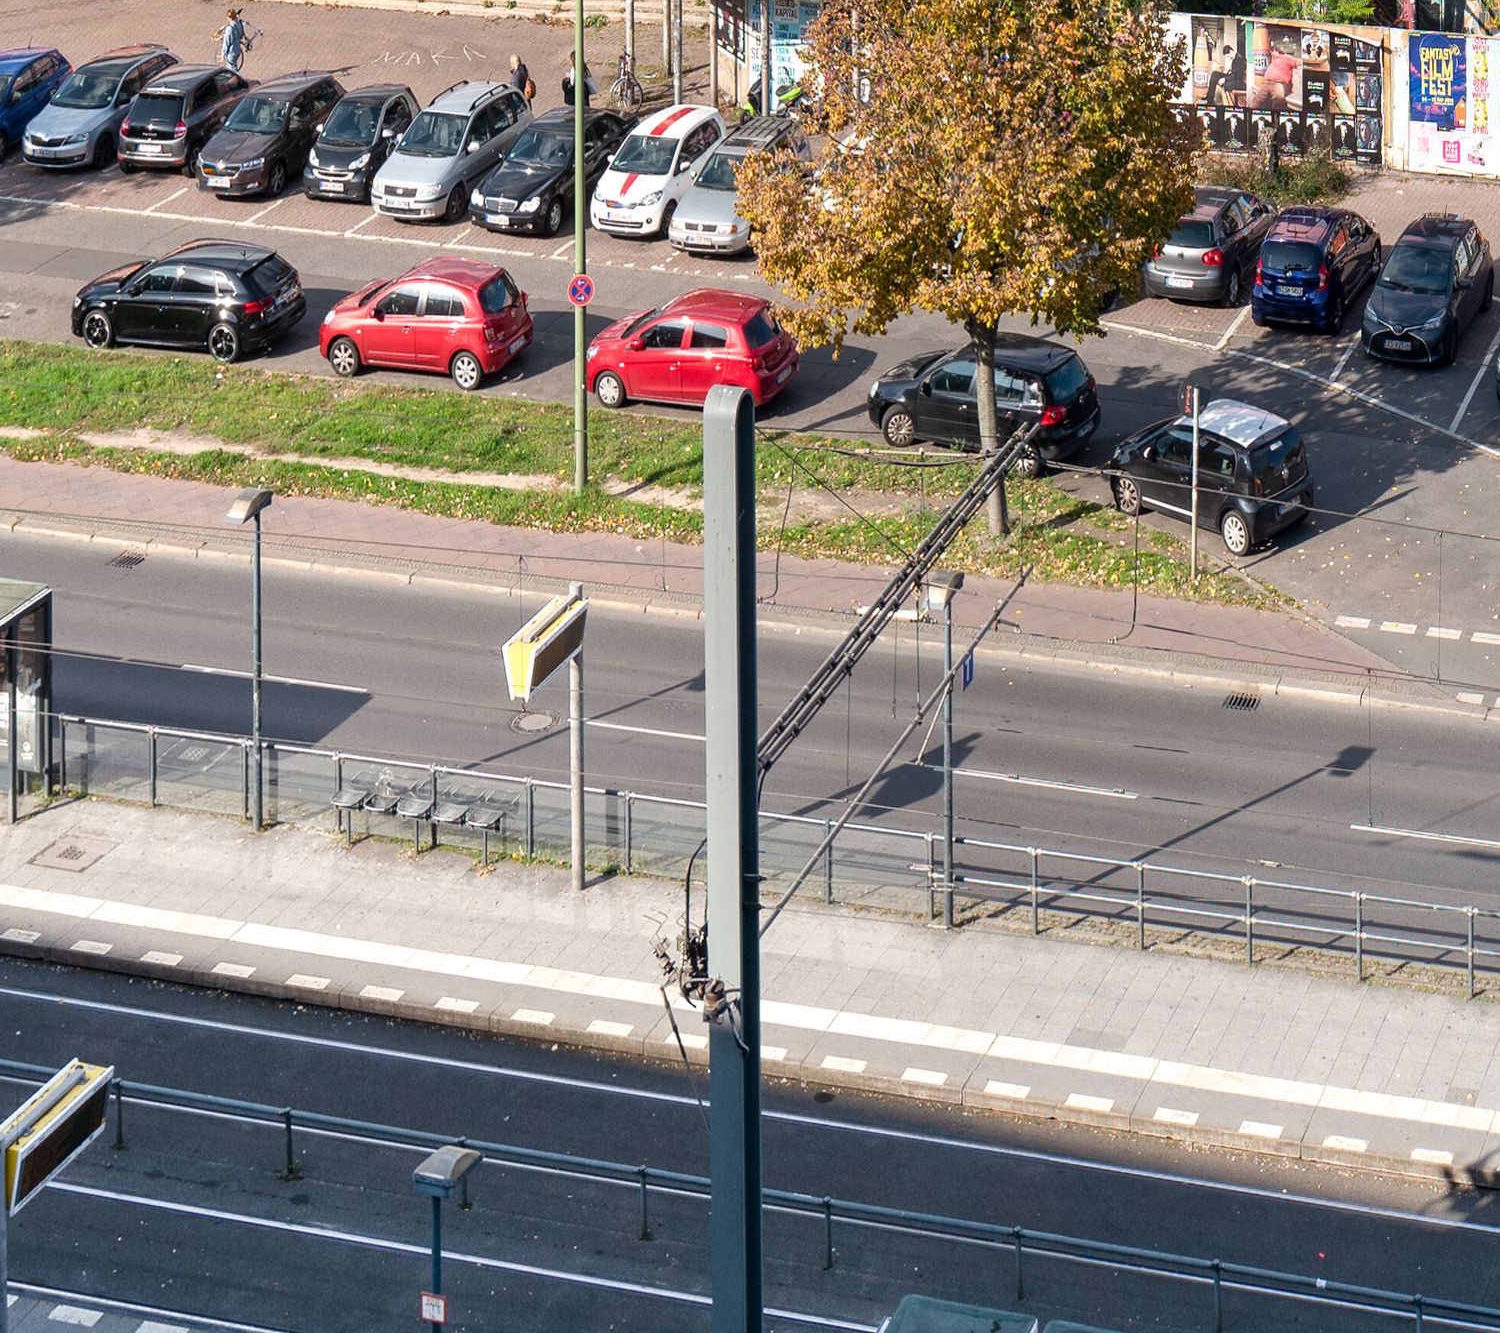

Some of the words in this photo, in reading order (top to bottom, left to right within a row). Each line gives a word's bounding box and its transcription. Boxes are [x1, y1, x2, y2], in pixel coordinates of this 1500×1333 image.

[1421, 47, 1454, 61] FANTASY
[1421, 58, 1454, 81] FILM
[1421, 77, 1452, 96] FEST
